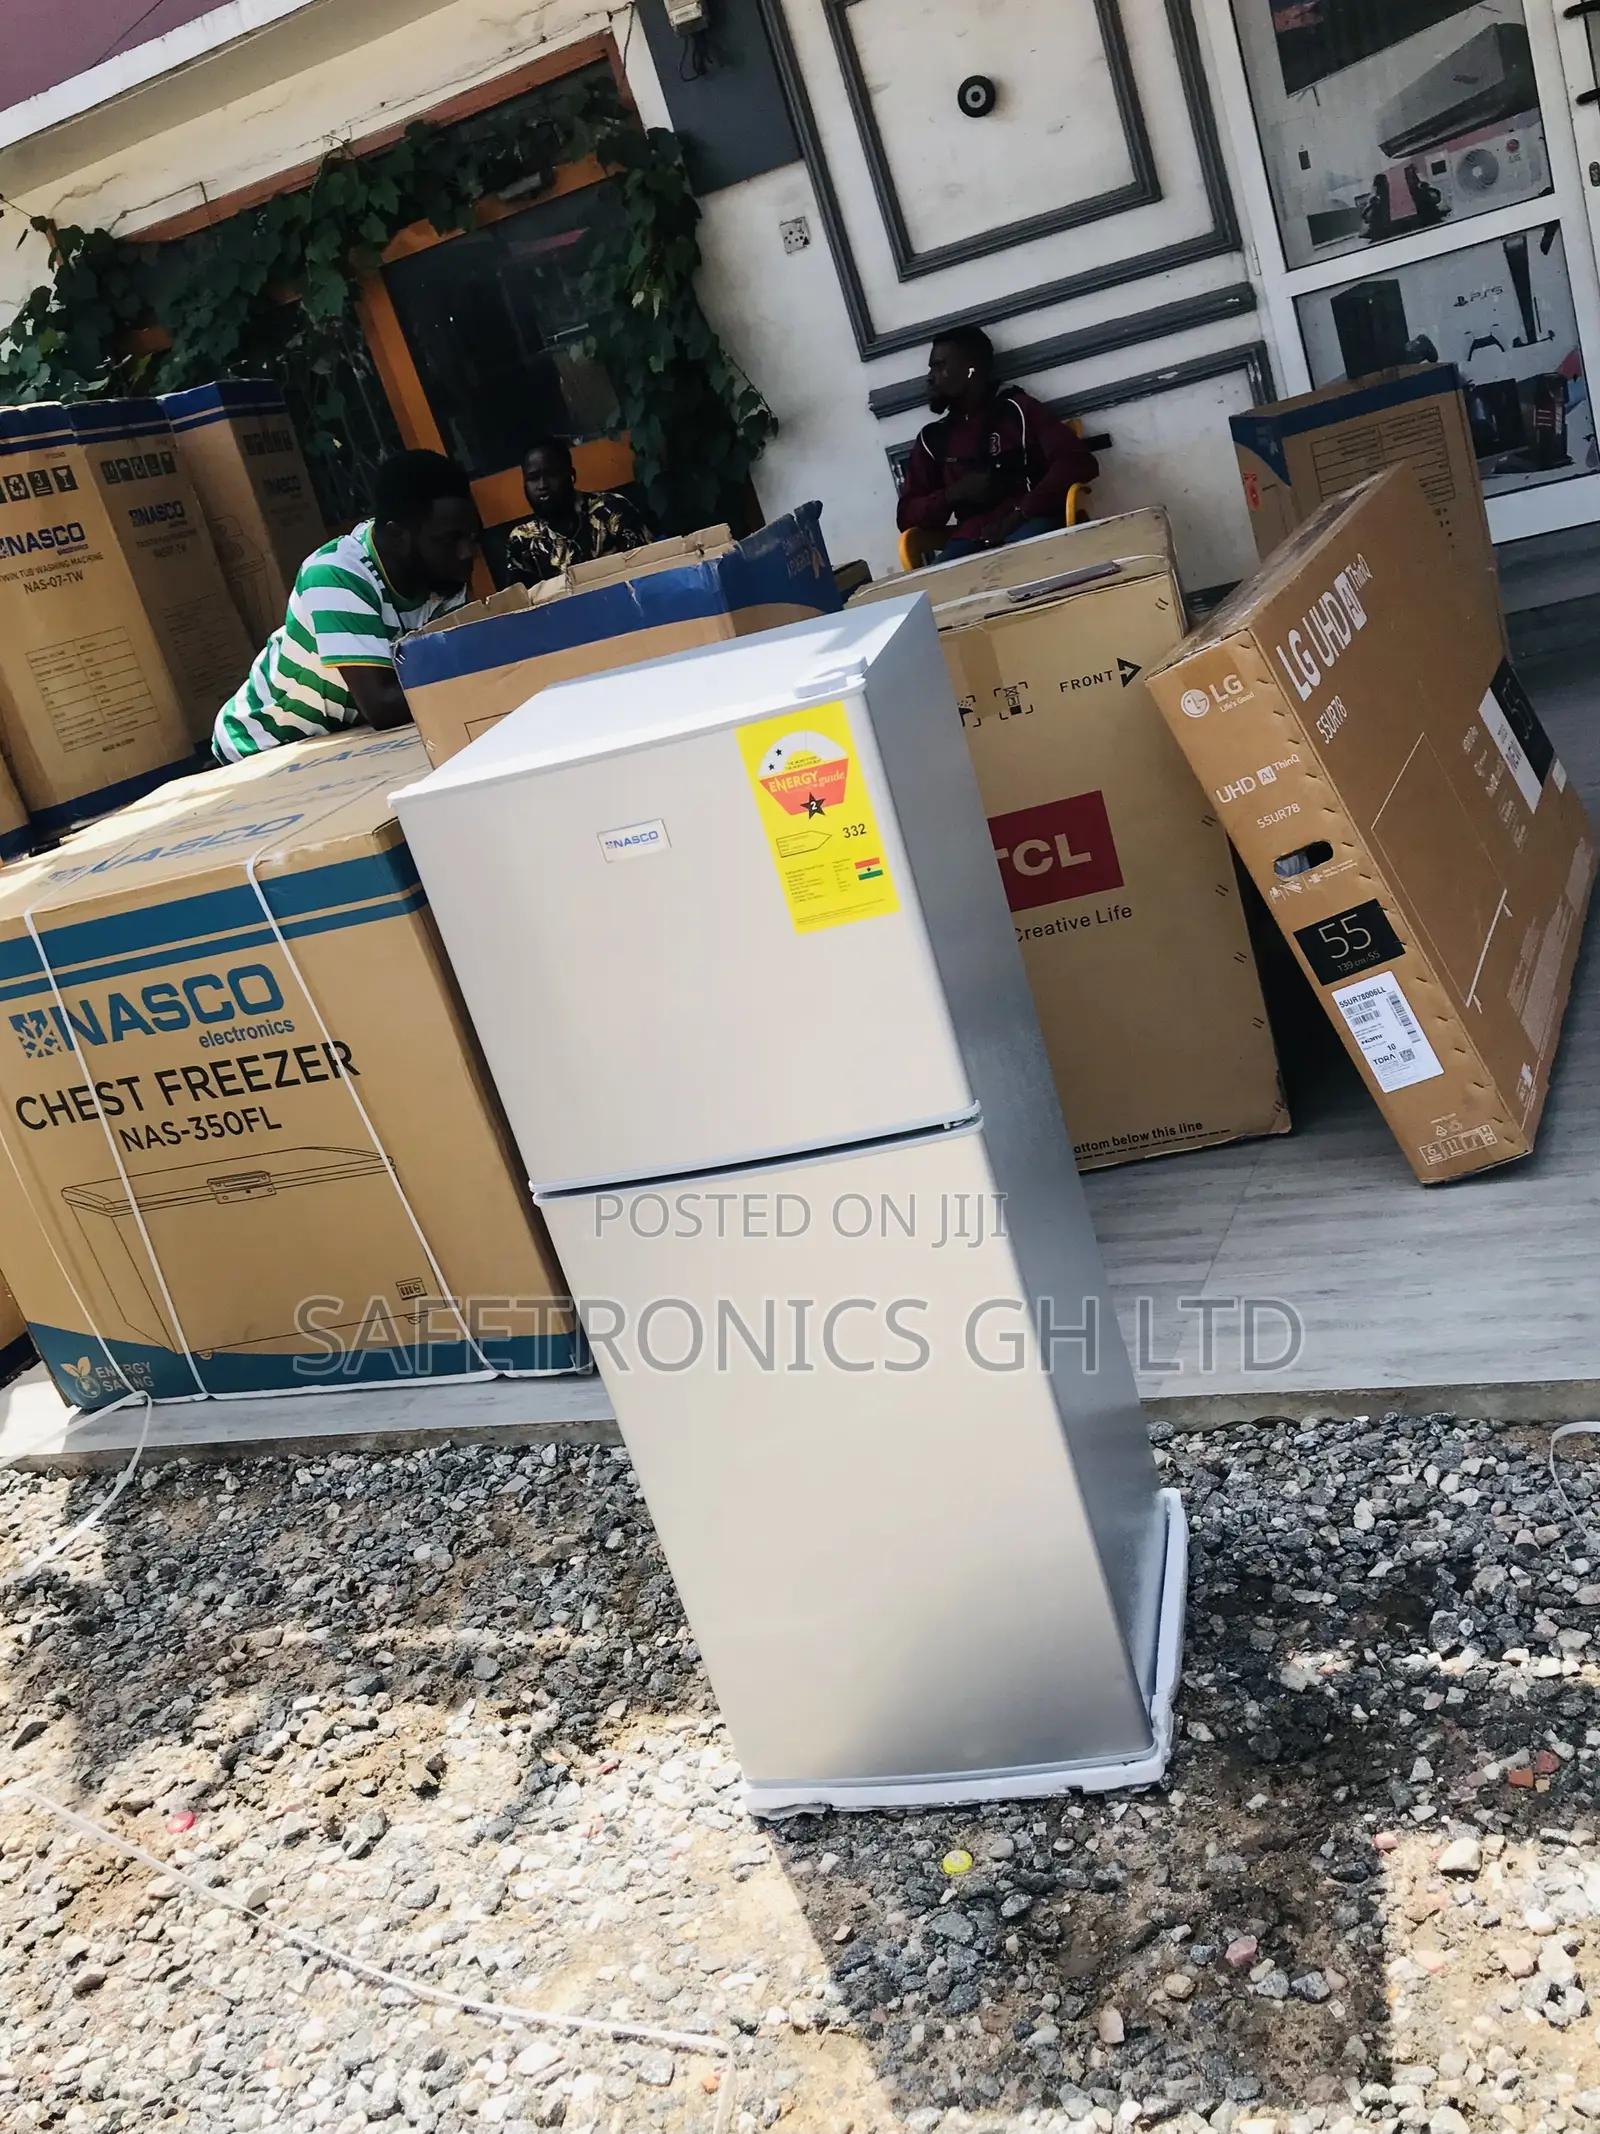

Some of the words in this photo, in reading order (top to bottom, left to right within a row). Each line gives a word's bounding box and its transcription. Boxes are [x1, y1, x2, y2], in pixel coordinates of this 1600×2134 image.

[138, 501, 185, 526] NASCO
[6, 522, 86, 557] NASCO
[23, 570, 84, 595] NAS-07-TW
[1276, 629, 1321, 702] LG
[1302, 591, 1352, 667] UHD
[1345, 553, 1374, 591] ThinQ
[1059, 669, 1114, 693] FRONT
[1209, 674, 1244, 703] LG
[1237, 692, 1256, 706] Good
[1316, 695, 1349, 745] 55UR78
[767, 770, 819, 793] ENERGY
[819, 769, 846, 788] guide
[1215, 776, 1257, 804] UHD
[1271, 754, 1301, 771] ThinQ
[810, 801, 818, 811] 2
[1256, 803, 1301, 829] 55UR78
[613, 830, 659, 848] NASCO
[842, 823, 867, 839] 332
[1095, 904, 1133, 924] Life
[1318, 913, 1372, 958] 55
[1337, 961, 1354, 972] 139
[48, 963, 285, 1052] NASCO
[198, 1016, 296, 1049] electronics
[1386, 1043, 1397, 1052] 10
[15, 1075, 145, 1131] CHEST
[154, 1040, 361, 1106] FREEZER
[118, 1105, 283, 1152] NAS-350FL
[1073, 1138, 1110, 1154] ottom
[1112, 1131, 1150, 1147] below
[1152, 1125, 1177, 1139] this
[1179, 1120, 1203, 1133] line
[95, 1361, 152, 1379] ENRGY
[102, 1376, 155, 1392] SANG
